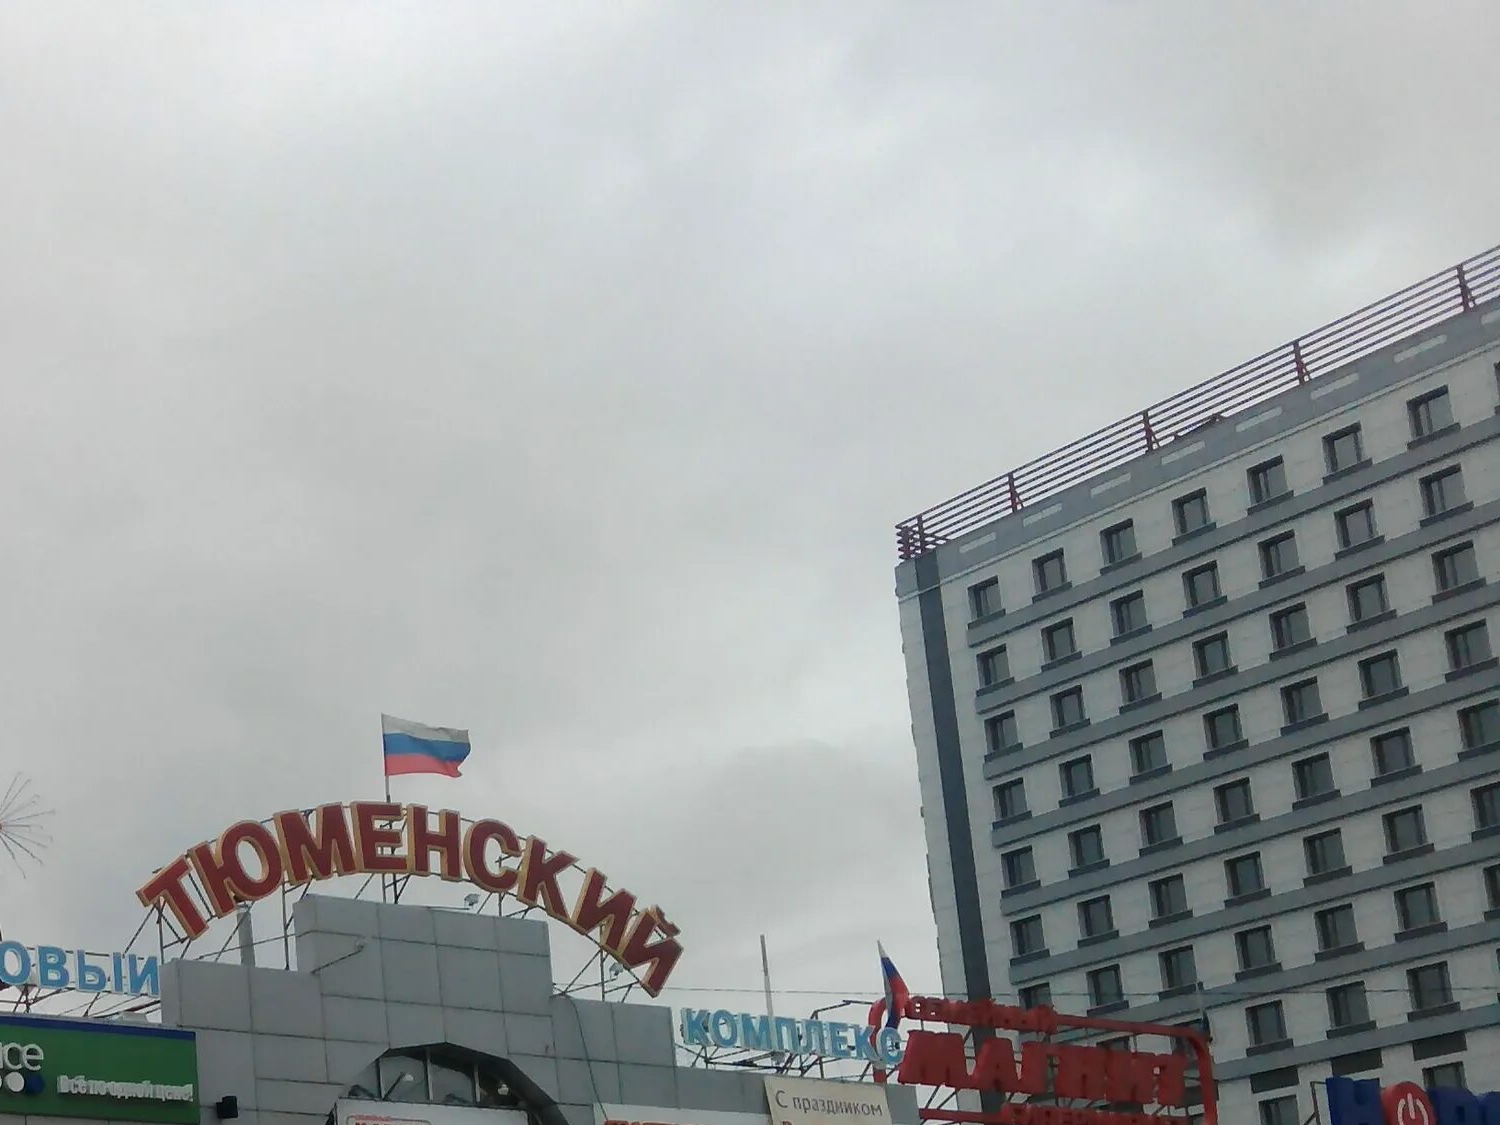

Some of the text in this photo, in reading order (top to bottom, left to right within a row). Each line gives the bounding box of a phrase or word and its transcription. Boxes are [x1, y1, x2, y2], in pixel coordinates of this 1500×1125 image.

[136, 800, 684, 998] ТЮМЕНСКИЙ
[680, 1007, 903, 1067] КОМПЛЕКС
[775, 1090, 884, 1118] С праздником
